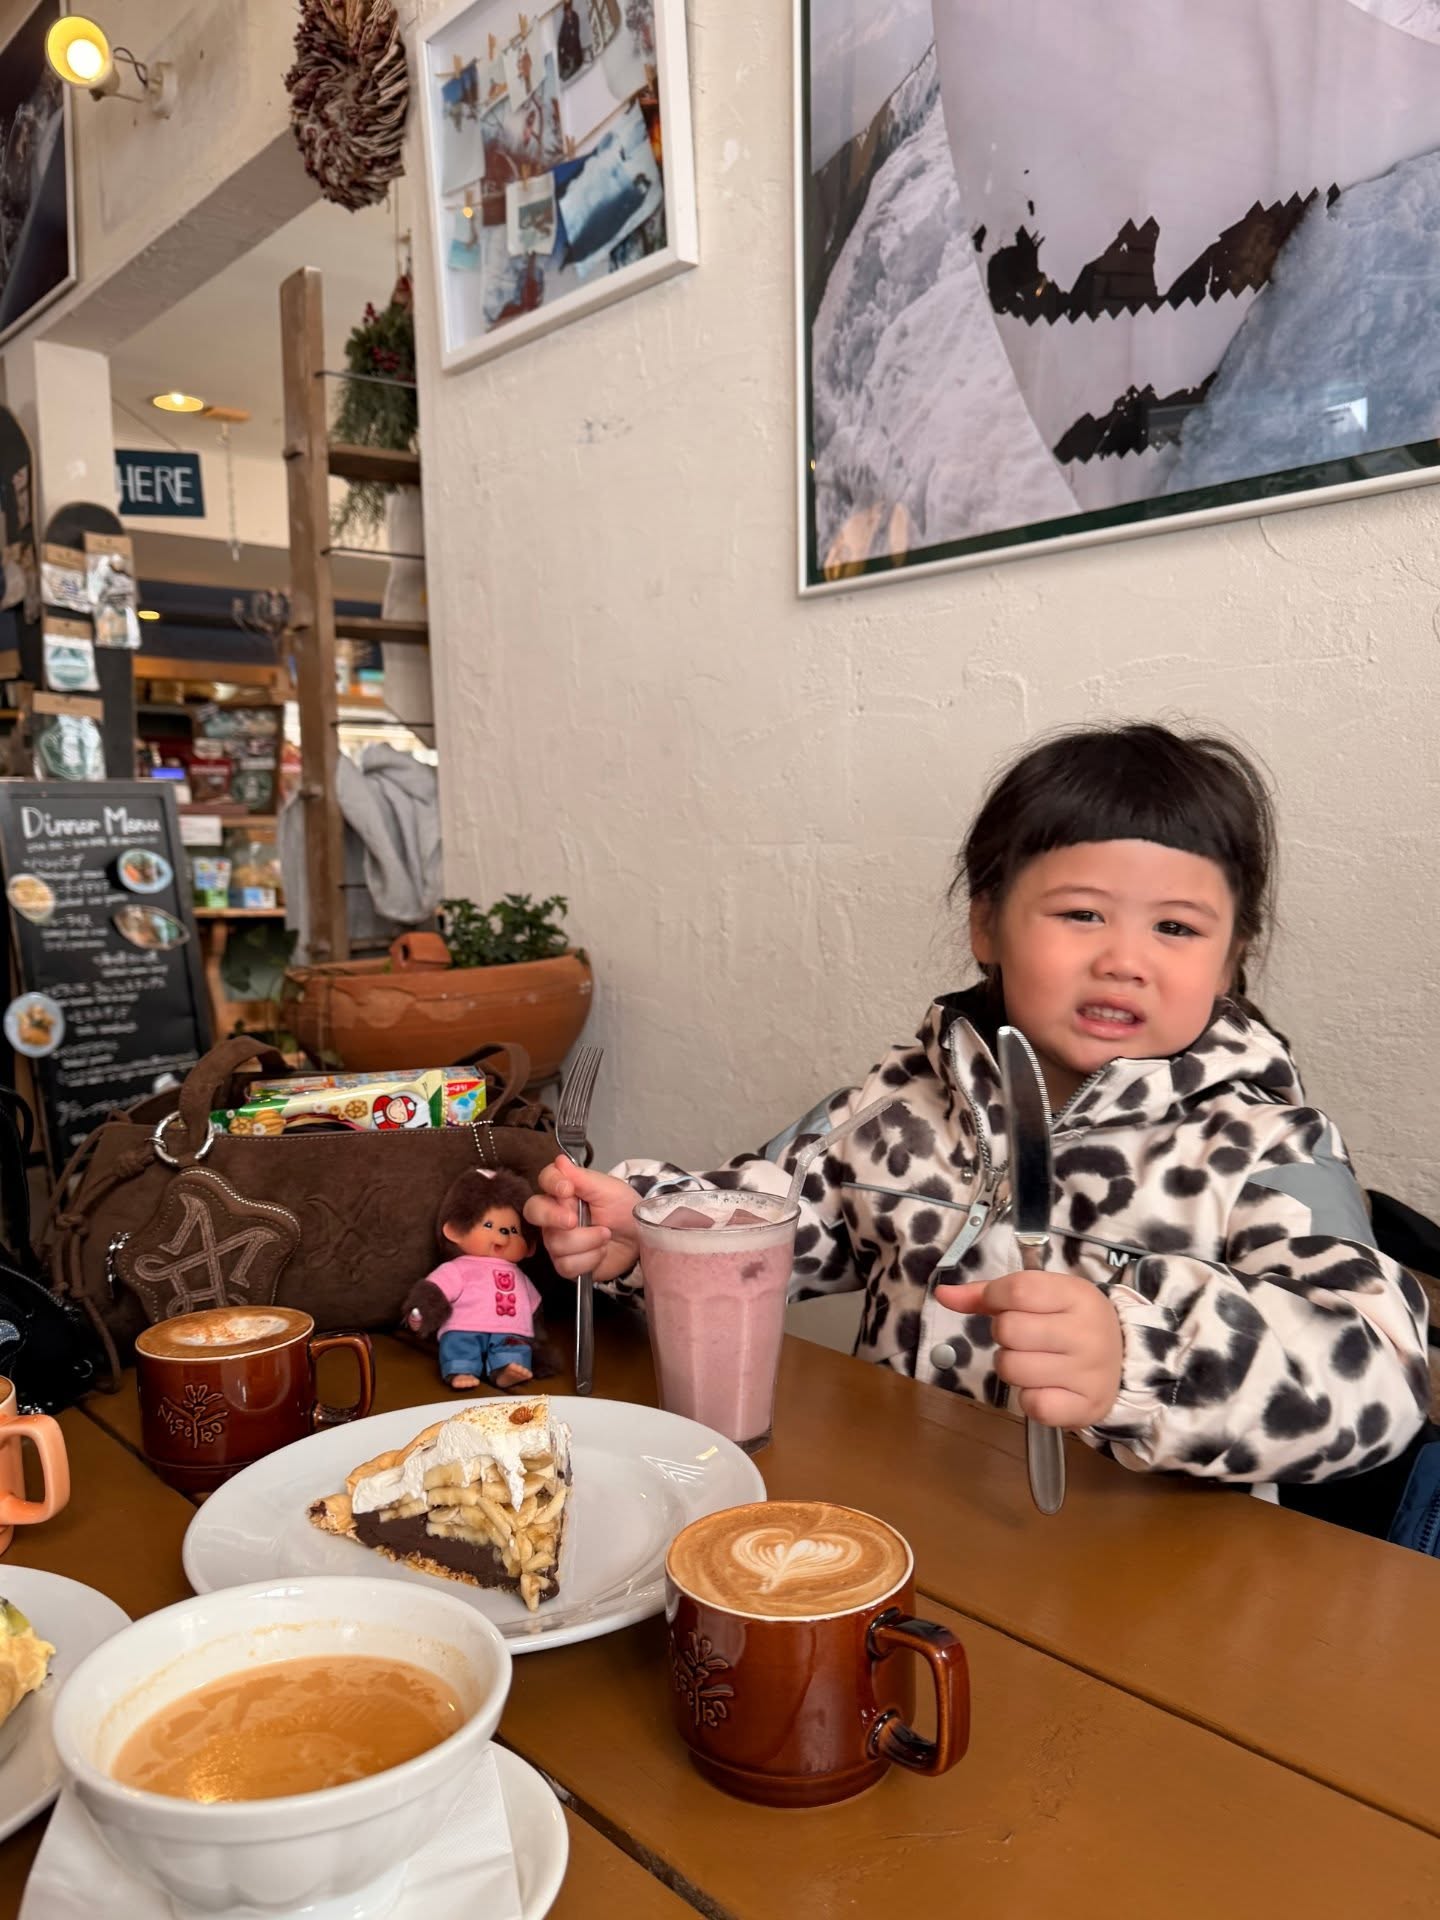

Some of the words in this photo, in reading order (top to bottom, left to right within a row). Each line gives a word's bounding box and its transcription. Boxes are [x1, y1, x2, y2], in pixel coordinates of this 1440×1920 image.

[115, 464, 195, 506] HERE
[21, 806, 99, 839] Dinner
[103, 806, 161, 835] Menu
[157, 1403, 223, 1443] Niseko
